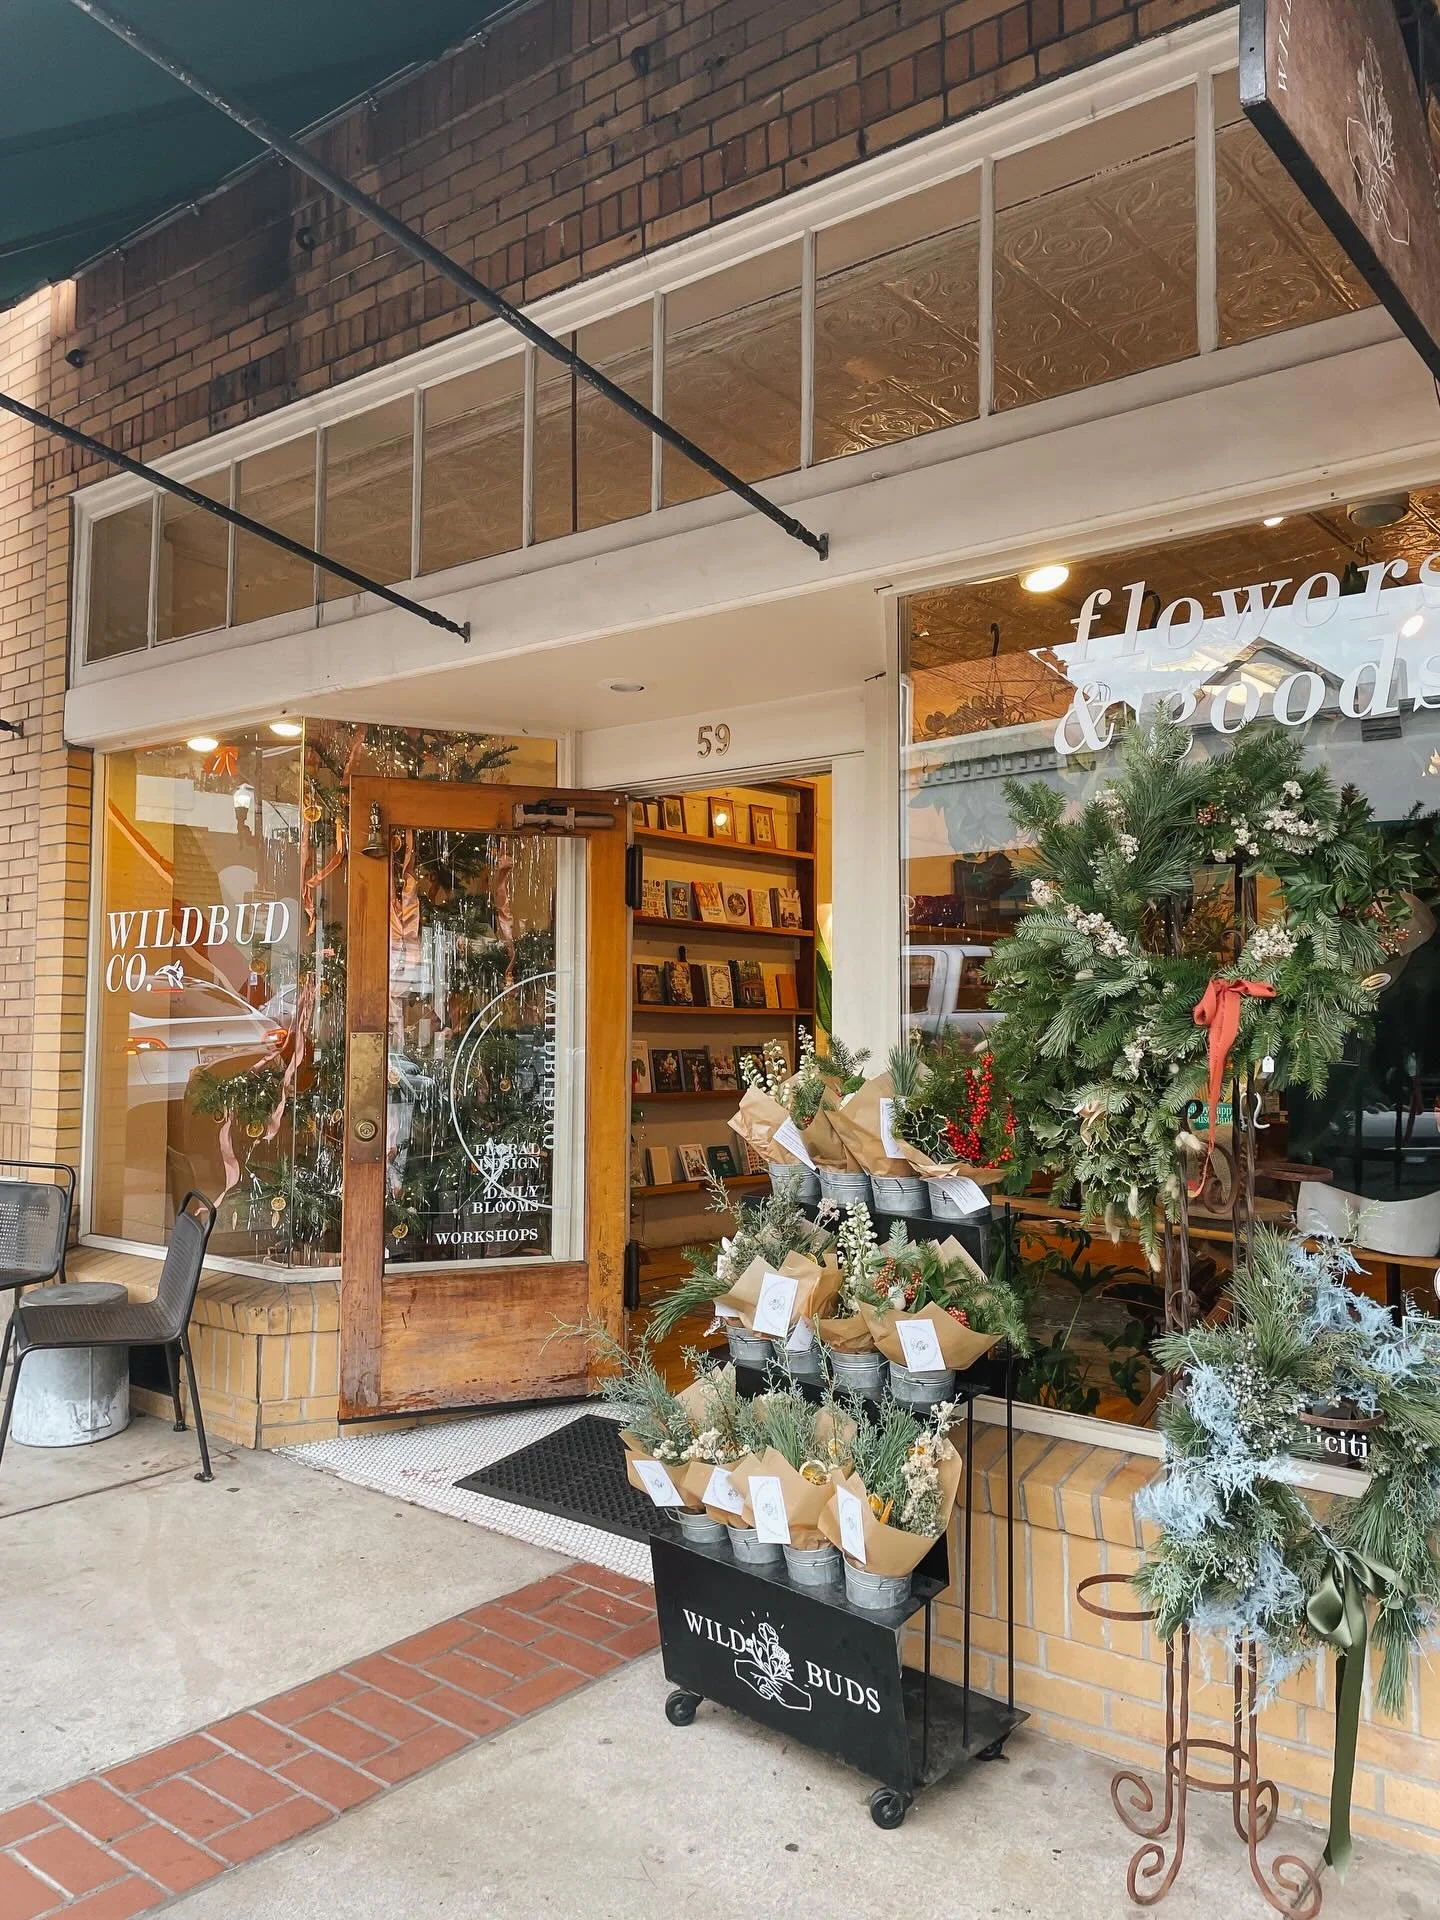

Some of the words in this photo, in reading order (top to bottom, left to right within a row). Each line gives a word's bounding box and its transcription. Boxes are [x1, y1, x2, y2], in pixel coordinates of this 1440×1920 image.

[1054, 680, 1118, 755] &
[697, 723, 731, 758] 59
[107, 901, 290, 950] WILDBUD
[106, 953, 152, 993] CO.
[472, 1199, 539, 1214] BLOOMS
[486, 1185, 540, 1200] DAILY
[435, 1228, 538, 1245] WORKSHOPS
[682, 1608, 746, 1653] WILD
[805, 1660, 881, 1713] BUDS
